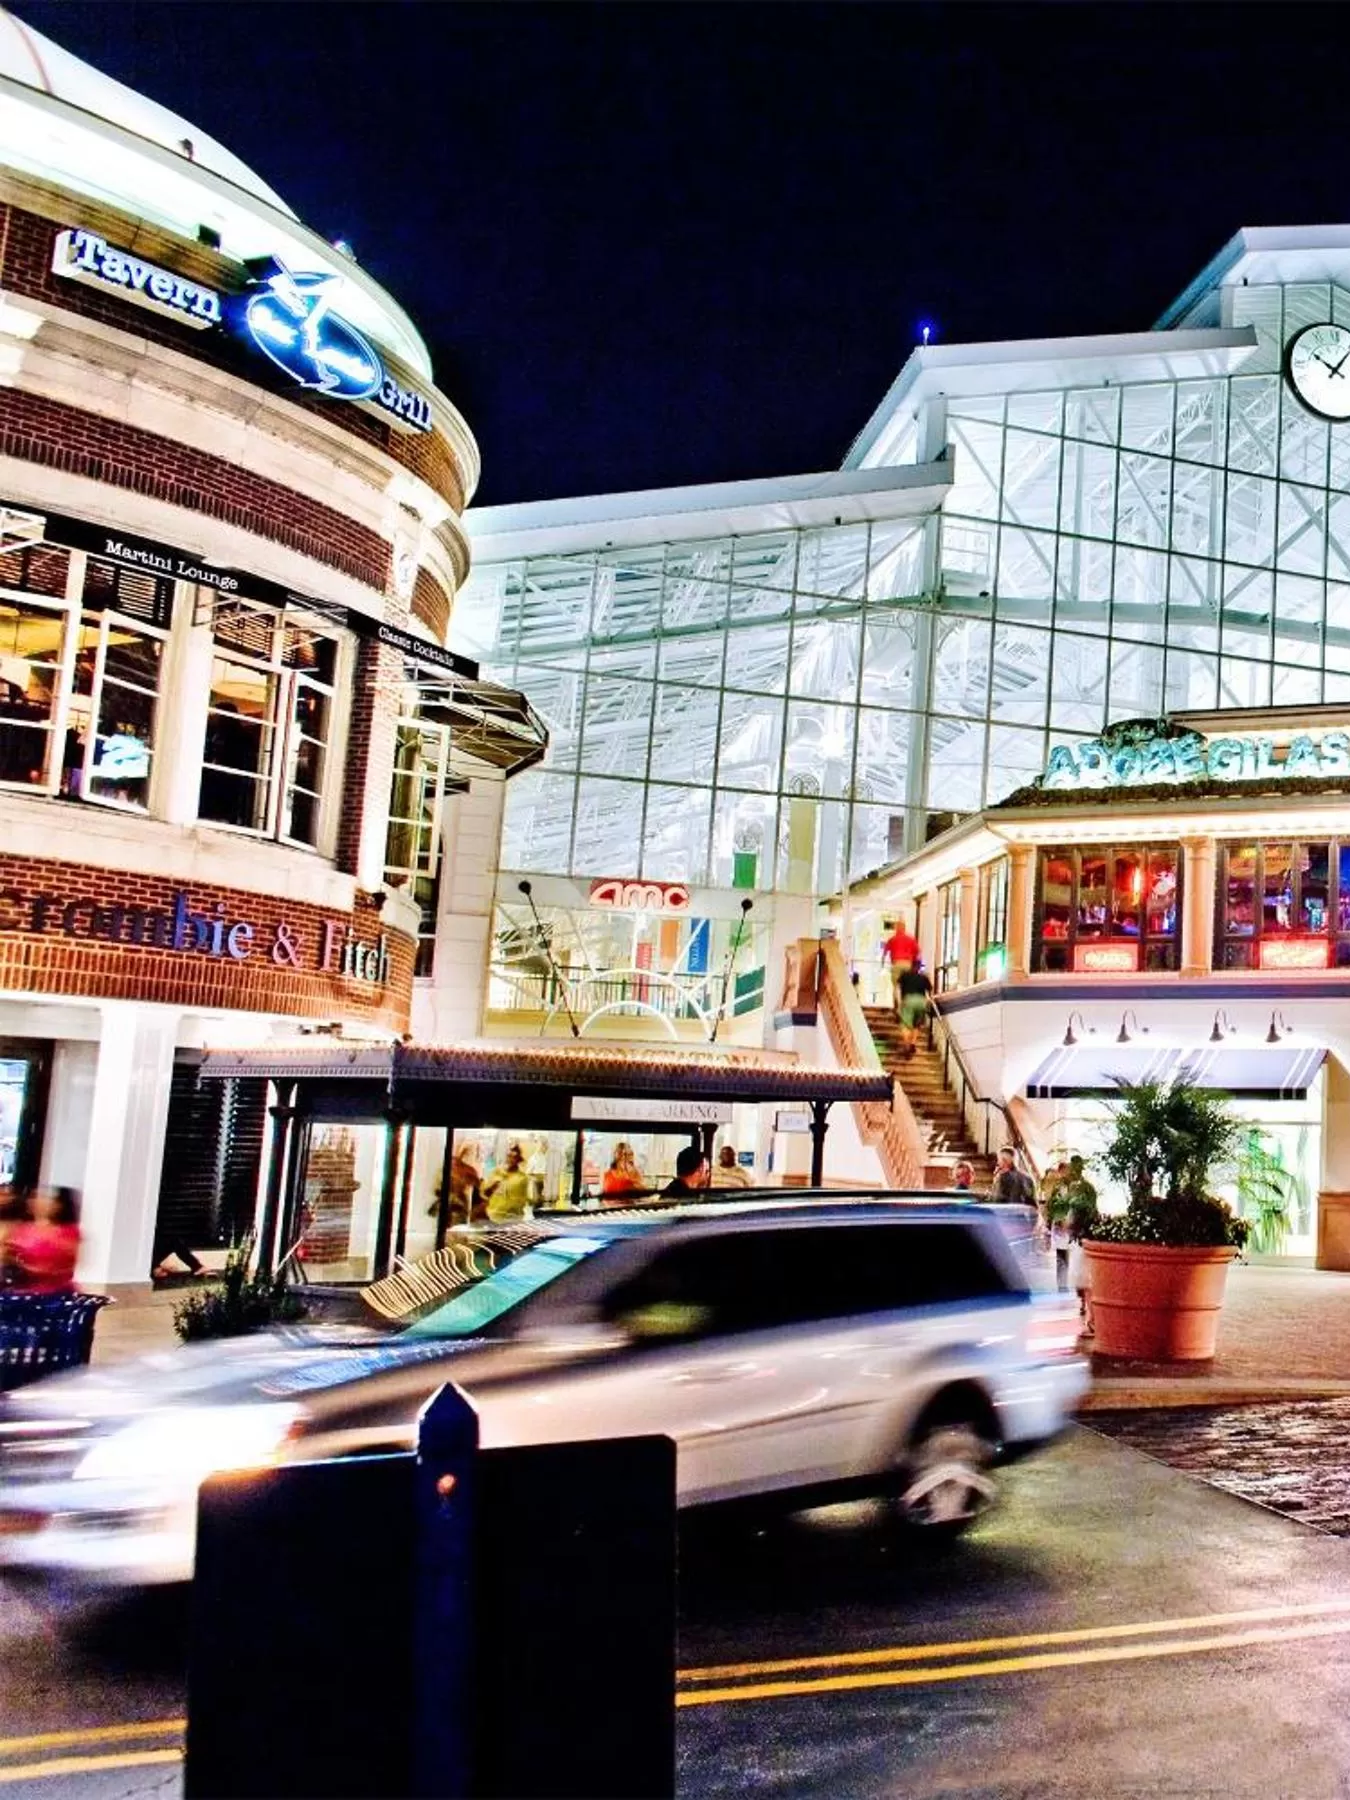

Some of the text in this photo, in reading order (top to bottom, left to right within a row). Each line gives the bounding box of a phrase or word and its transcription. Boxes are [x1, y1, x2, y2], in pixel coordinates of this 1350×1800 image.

[74, 229, 222, 323] Tavern
[377, 375, 433, 432] Grill
[105, 539, 239, 590] Martini Lounge
[1045, 732, 1207, 784] ADOBE
[272, 922, 303, 968] &
[319, 918, 392, 984] Fitch
